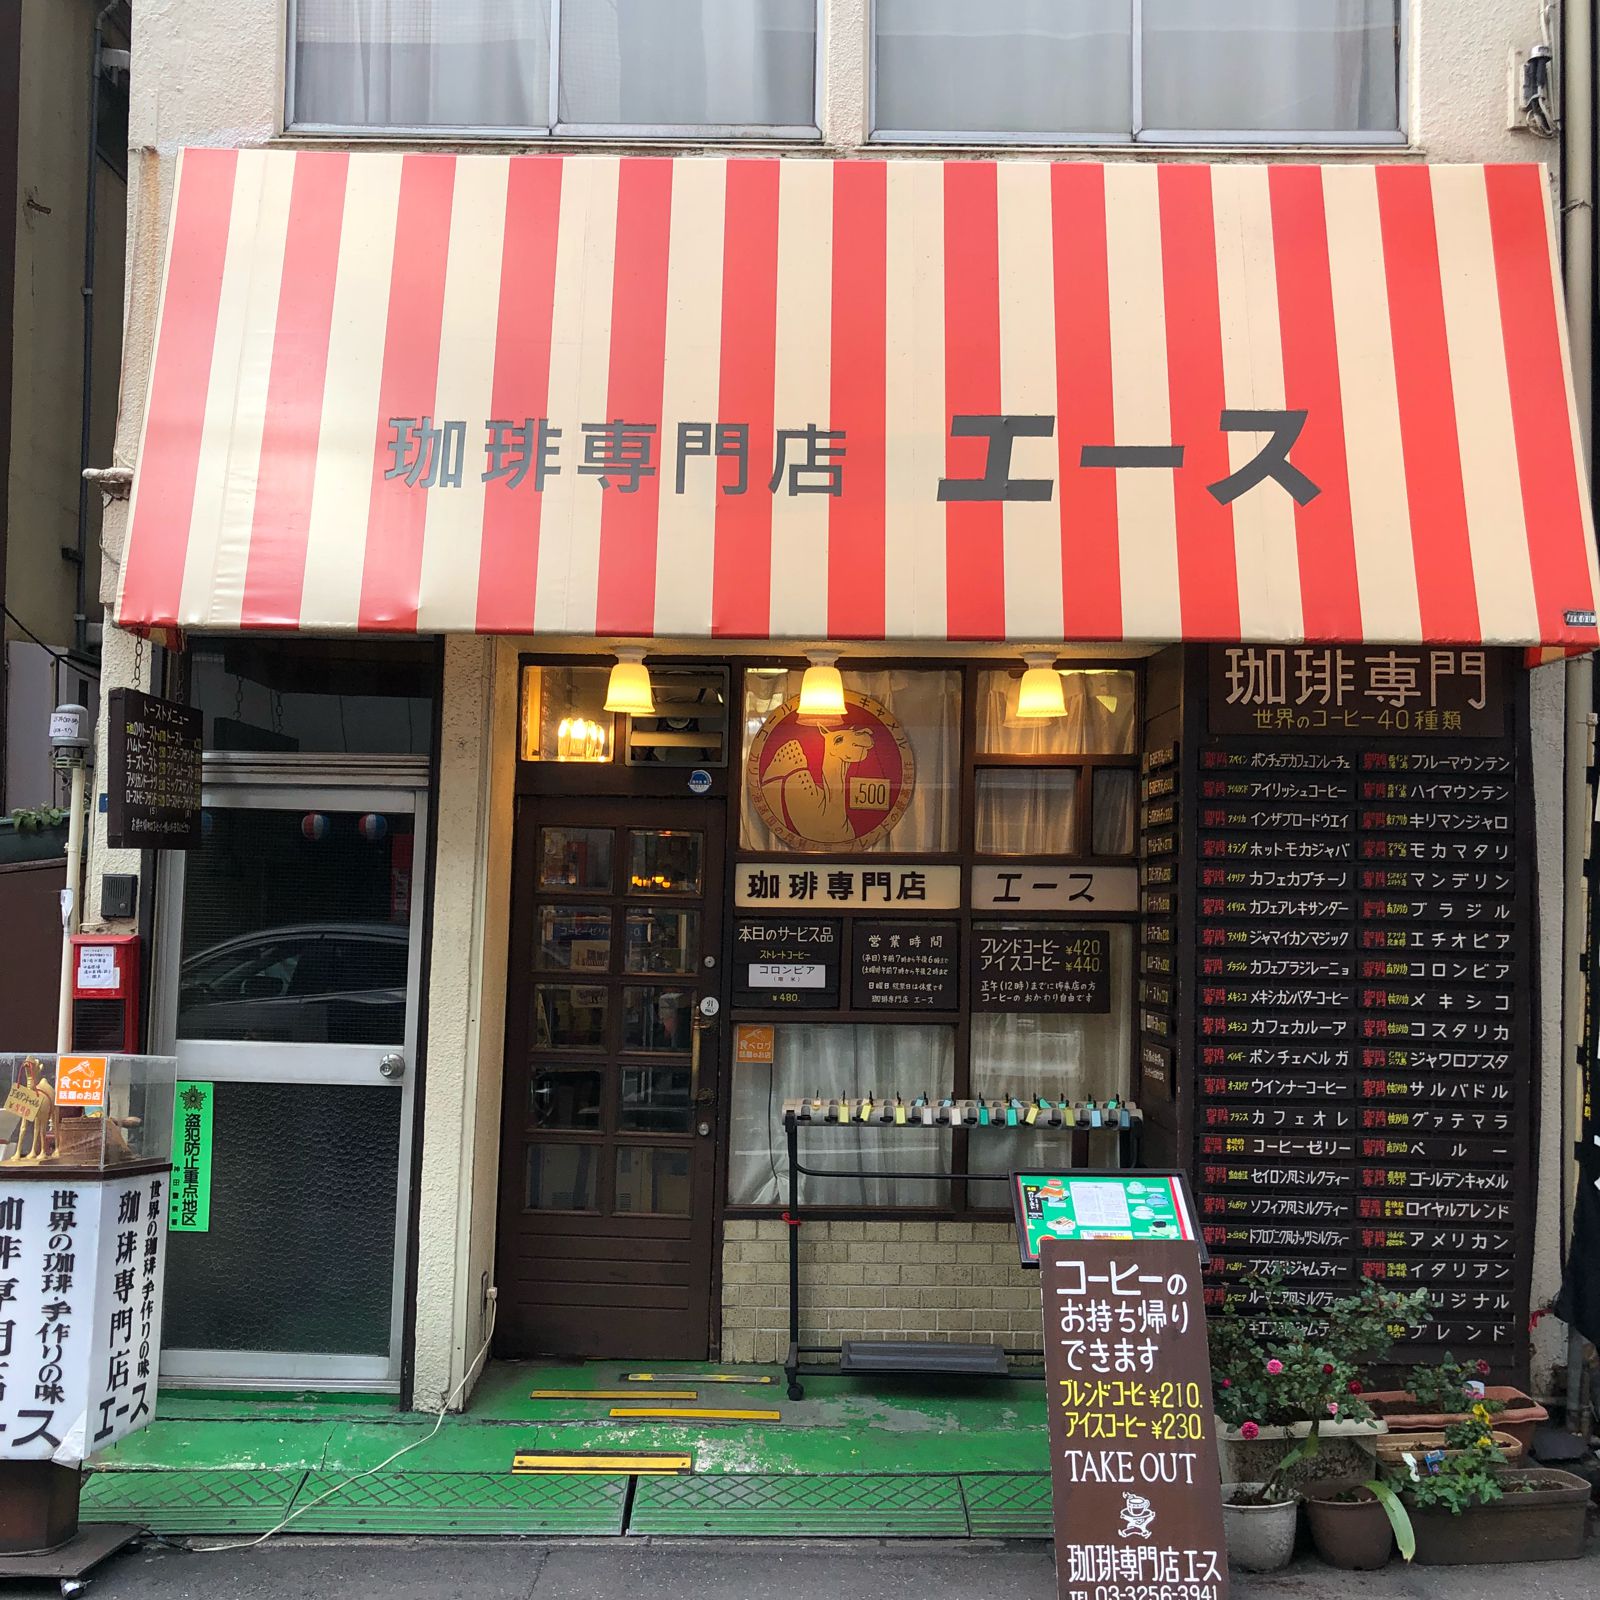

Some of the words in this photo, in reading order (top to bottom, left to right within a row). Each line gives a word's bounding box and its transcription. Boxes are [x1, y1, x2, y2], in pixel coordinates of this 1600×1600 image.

[384, 416, 847, 497] 珈琲専門店
[937, 410, 1322, 507] エース
[1225, 648, 1486, 710] 珈琲専門
[144, 701, 189, 725] トーストメニュー
[1253, 709, 1462, 731] 世界のコーヒー40種類
[1411, 754, 1510, 771] ブルーマウンテン
[854, 783, 886, 805] ¥500
[1250, 783, 1347, 798] アイリッシュコーヒー
[1411, 785, 1509, 800] ハイマウンテン
[1410, 813, 1507, 830] キリマンジャロ
[1250, 842, 1350, 858] ホットモカジャバ
[1410, 843, 1508, 859] モカマタリ
[747, 870, 926, 901] 珈琲専門店
[992, 873, 1095, 902] エース
[1250, 871, 1346, 887] カフェカプチーノ
[1411, 873, 1509, 889] マンデリン
[1250, 900, 1349, 916] カフェアレキサンダー
[1411, 902, 1510, 919] ブラジル
[738, 926, 834, 943] 本日のサービス品
[868, 935, 943, 948] 営業時間
[1250, 930, 1349, 946] ジャマイカンマジック
[1411, 933, 1509, 949] エチオピア
[980, 938, 1060, 955] ブレンドコーヒー
[760, 965, 816, 975] コロンビア
[980, 955, 1061, 972] アイスコーヒー
[1250, 960, 1349, 976] カフェブラジレーニョ
[1410, 963, 1509, 979] コロンビア
[1227, 992, 1247, 1002] メキシコ
[1250, 989, 1349, 1005] メキシカンバターコーヒー
[1411, 993, 1508, 1010] メキシコ
[1228, 1022, 1247, 1032] メキシコ
[1251, 1019, 1347, 1036] カフェカルーア
[1411, 1023, 1508, 1040] コスタリカ
[1411, 1052, 1508, 1069] ジャワロブスタ
[60, 1076, 102, 1089] 食べログ
[1251, 1078, 1347, 1095] ウインナーコーヒー
[1410, 1081, 1508, 1099] サルバドル
[1252, 1109, 1349, 1127] カフェオレ
[1412, 1112, 1507, 1129] グァテマラ
[1253, 1139, 1351, 1155] コーヒーゼリー
[1411, 1142, 1507, 1157] ペルー
[182, 1113, 201, 1226] 盗犯防止重点地区
[1250, 1168, 1349, 1186] セイロン風ミルクティー
[1410, 1172, 1508, 1189] ゴールデンキャメル
[1251, 1200, 1348, 1217] ソフィア風ミルクティー
[1407, 1202, 1509, 1219] ロイヤルブレンド
[1410, 1232, 1508, 1250] アメリカン
[1055, 1260, 1188, 1295] コーヒーの
[1411, 1263, 1509, 1278] イタリアン
[35, 1190, 78, 1405] 世界の珈琲・手作りの味
[1431, 1293, 1509, 1309] リジナル
[1059, 1298, 1189, 1334] お持ち帰り
[1410, 1325, 1505, 1341] ブレンド
[1060, 1337, 1159, 1373] できます
[94, 1382, 149, 1443] エース
[1065, 1412, 1147, 1438] アイスコーヒー
[1064, 1450, 1135, 1482] TAKE
[1139, 1452, 1197, 1484] OUT
[1095, 1585, 1218, 1600] 03-3256-3941
